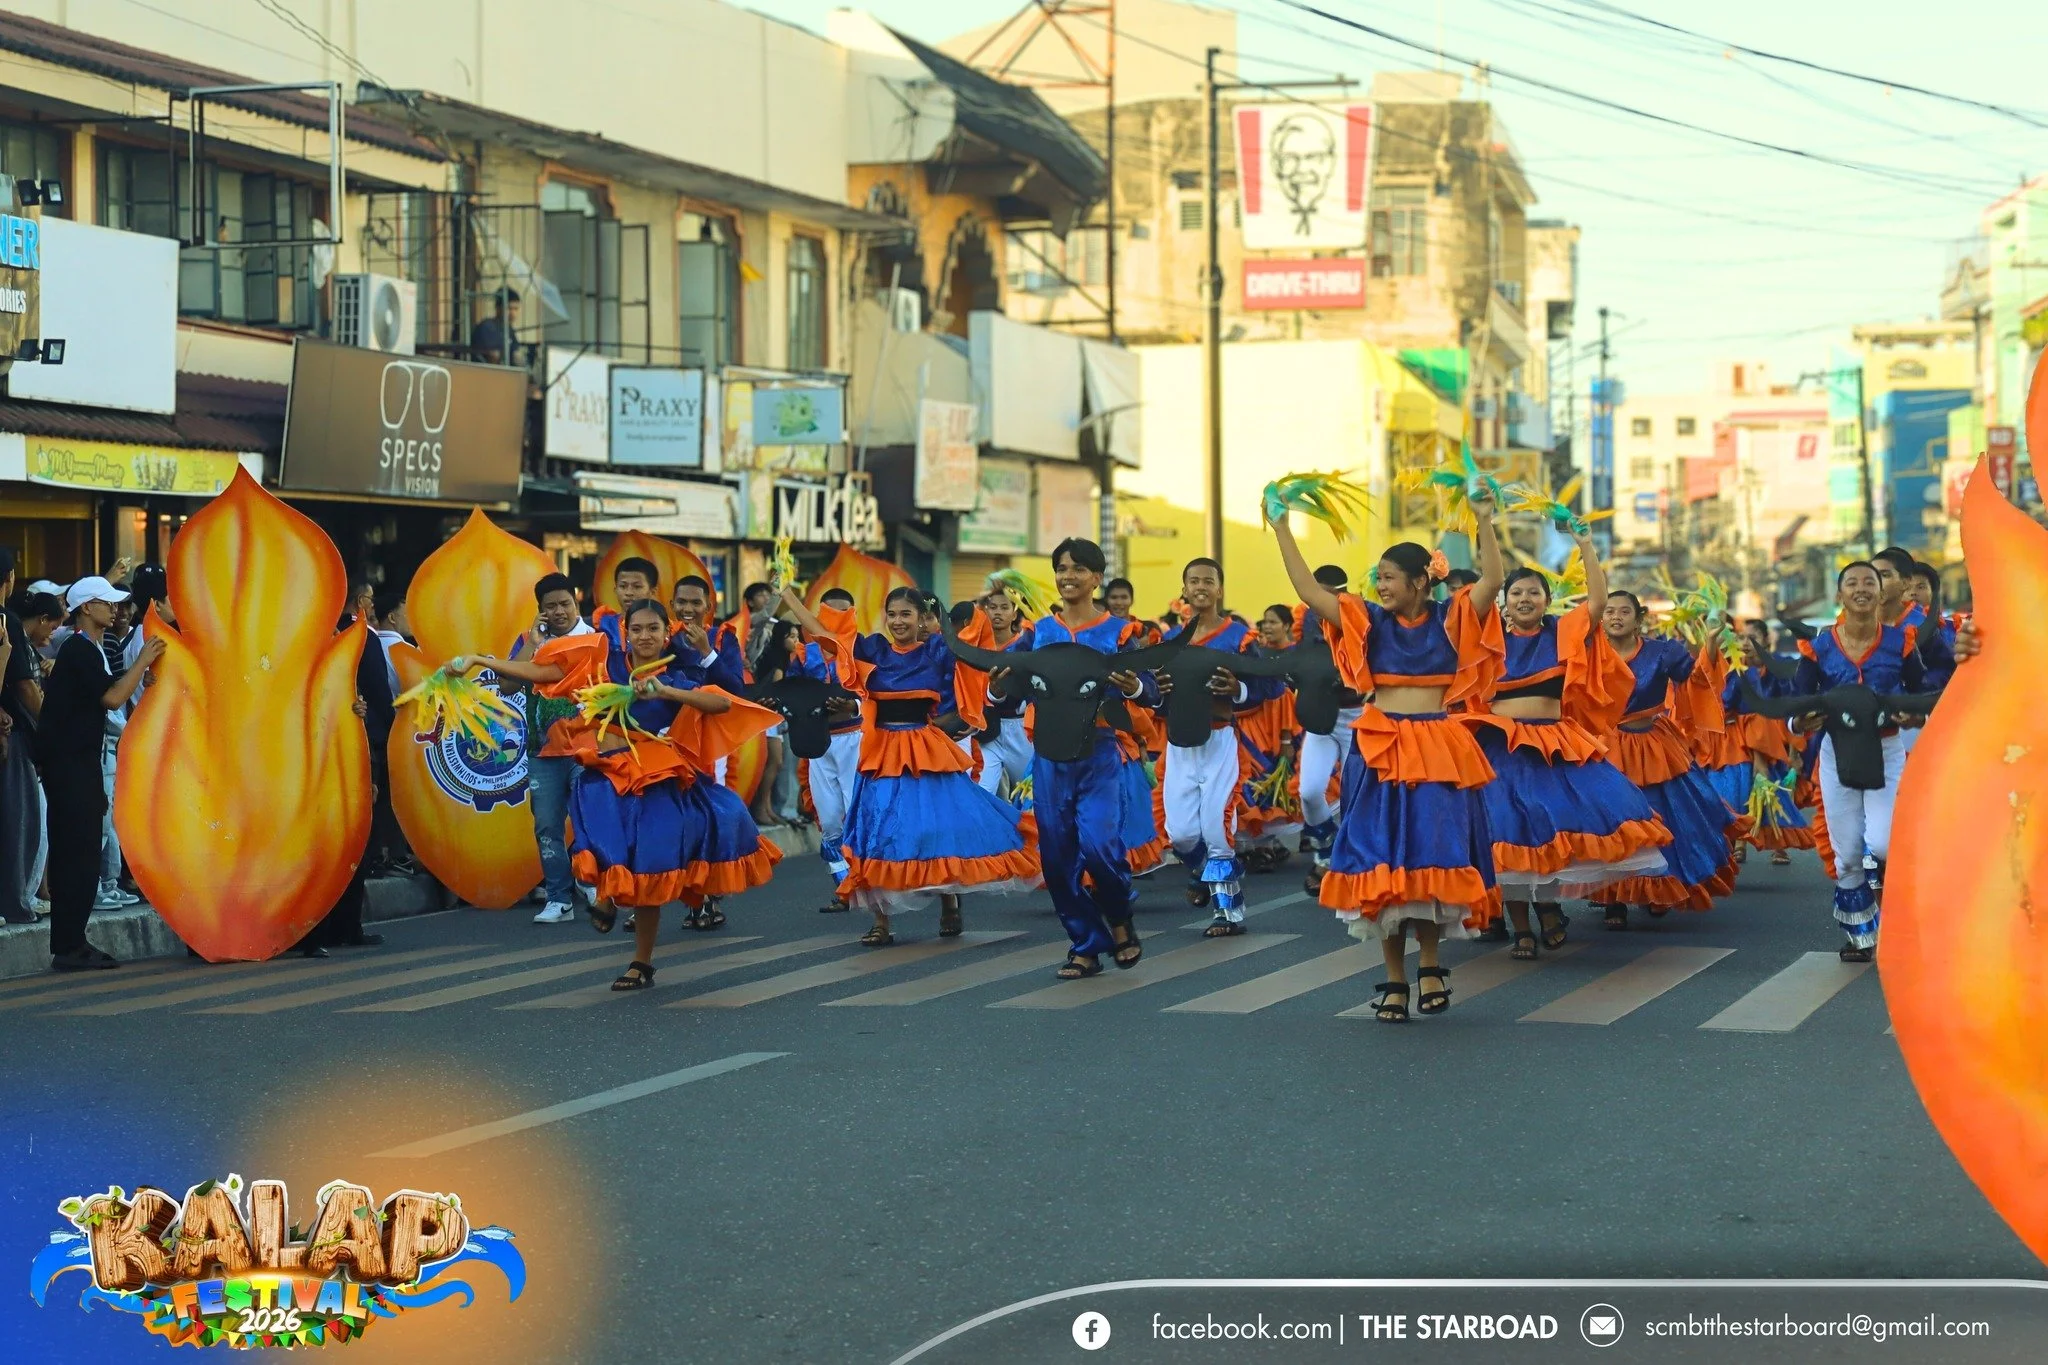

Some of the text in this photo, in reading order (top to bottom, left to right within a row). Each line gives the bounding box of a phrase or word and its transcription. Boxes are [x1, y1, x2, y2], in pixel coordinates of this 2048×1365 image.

[1246, 271, 1361, 297] DRIVE-THRU
[619, 386, 698, 417] PRAXY
[380, 437, 442, 472] SPECS
[405, 476, 439, 498] VISION
[777, 473, 879, 544] MILK tea
[482, 770, 516, 784] PHILIPPINES
